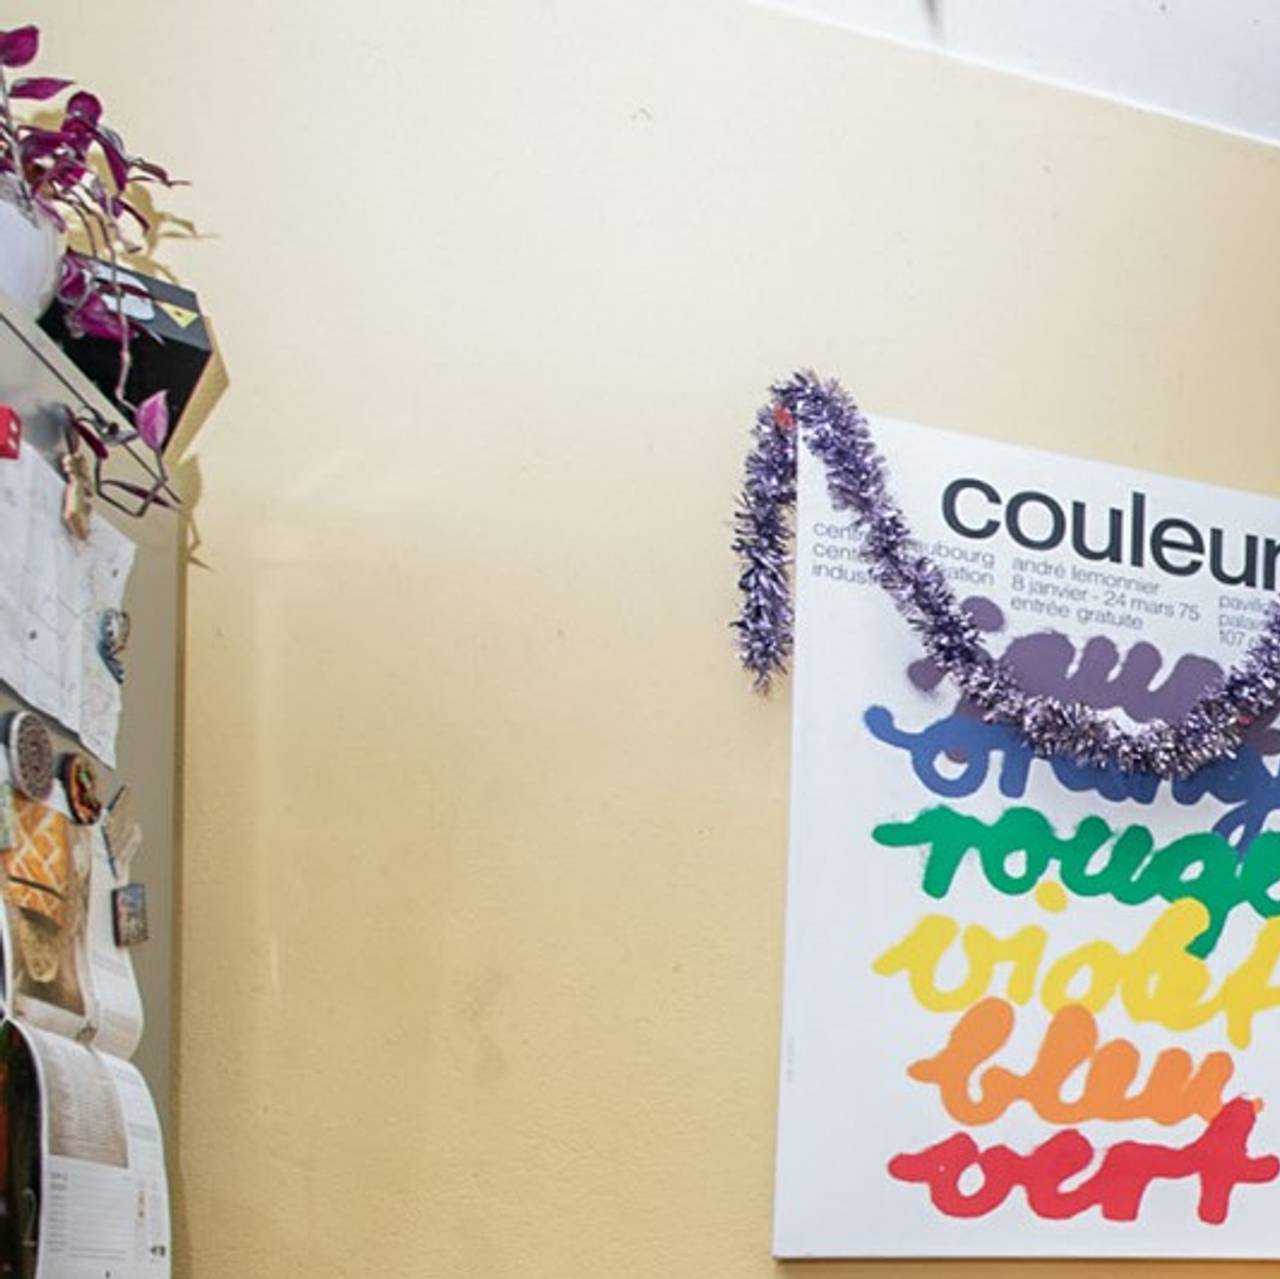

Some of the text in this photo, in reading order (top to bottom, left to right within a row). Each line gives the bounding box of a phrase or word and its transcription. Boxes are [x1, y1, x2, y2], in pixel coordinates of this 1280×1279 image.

[1011, 557, 1161, 595] andré lemonnier
[1011, 573, 1024, 592] 8
[1028, 579, 1087, 602] janvier
[1104, 590, 1126, 608] 24
[1130, 597, 1175, 619] mars
[1179, 602, 1201, 623] 75
[1010, 596, 1143, 630] entrée gratuite
[906, 996, 1264, 1127] bleu
